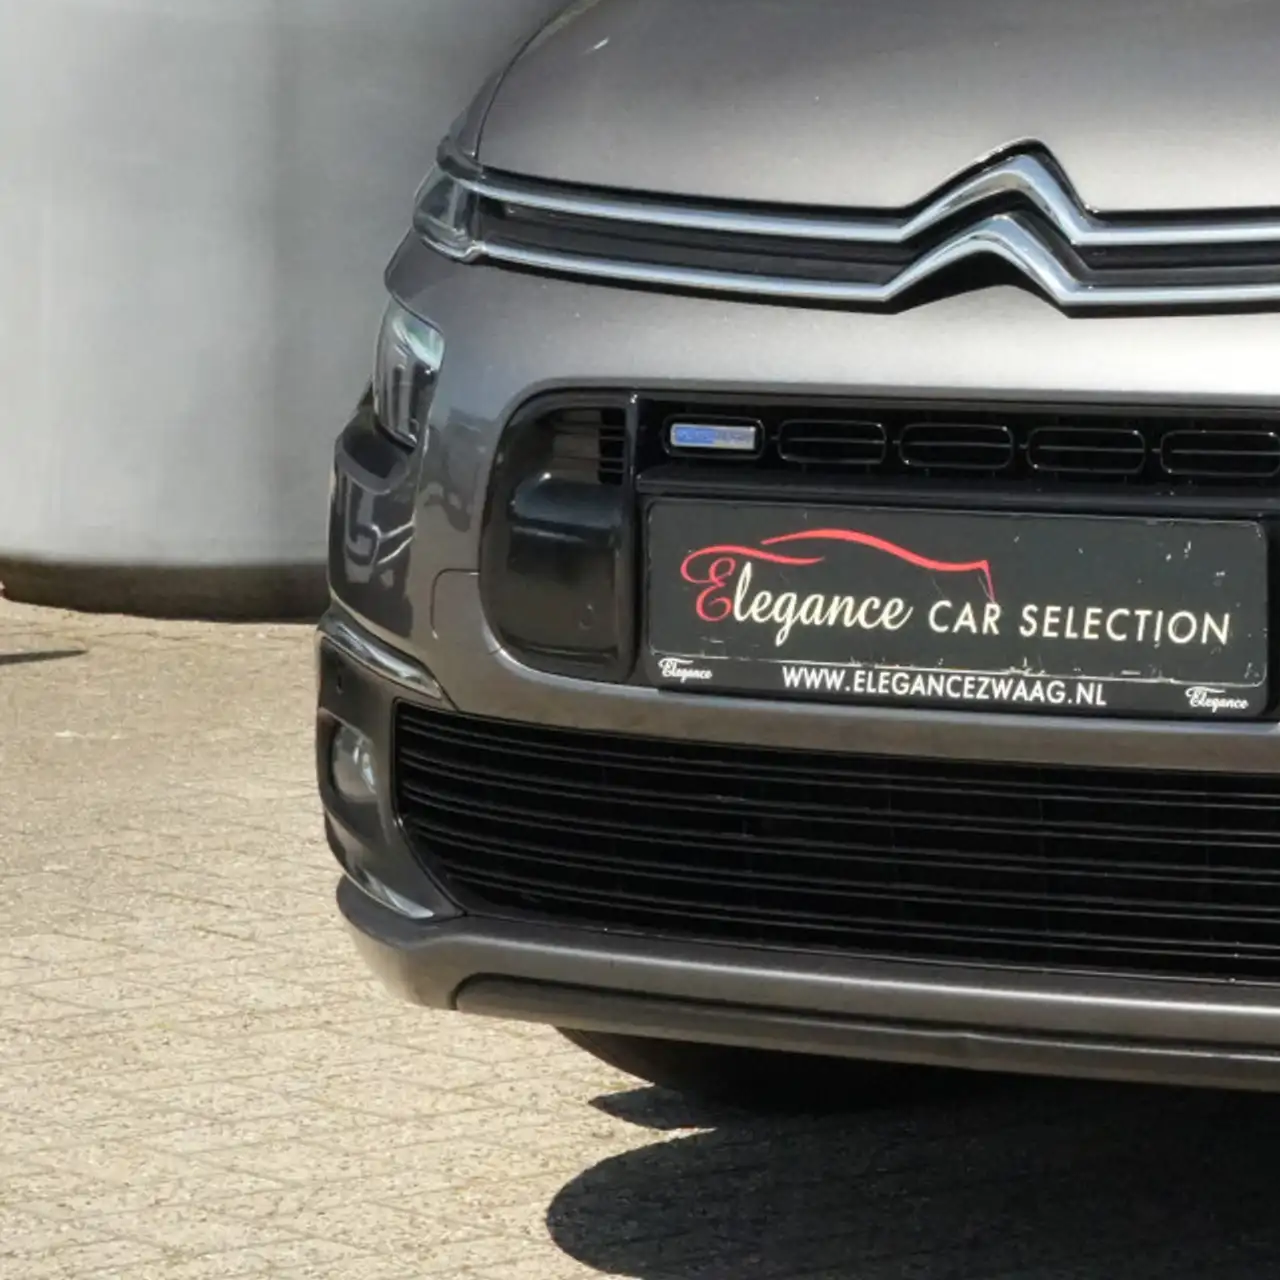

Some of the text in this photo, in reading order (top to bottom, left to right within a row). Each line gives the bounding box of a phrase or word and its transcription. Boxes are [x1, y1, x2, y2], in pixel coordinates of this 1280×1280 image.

[680, 544, 1230, 647] Elegance CAR SELECTION
[657, 657, 713, 683] Elegance
[782, 665, 1107, 706] WWW.ELEGANCEZWAAG.NL
[1185, 685, 1250, 713] Elegance
